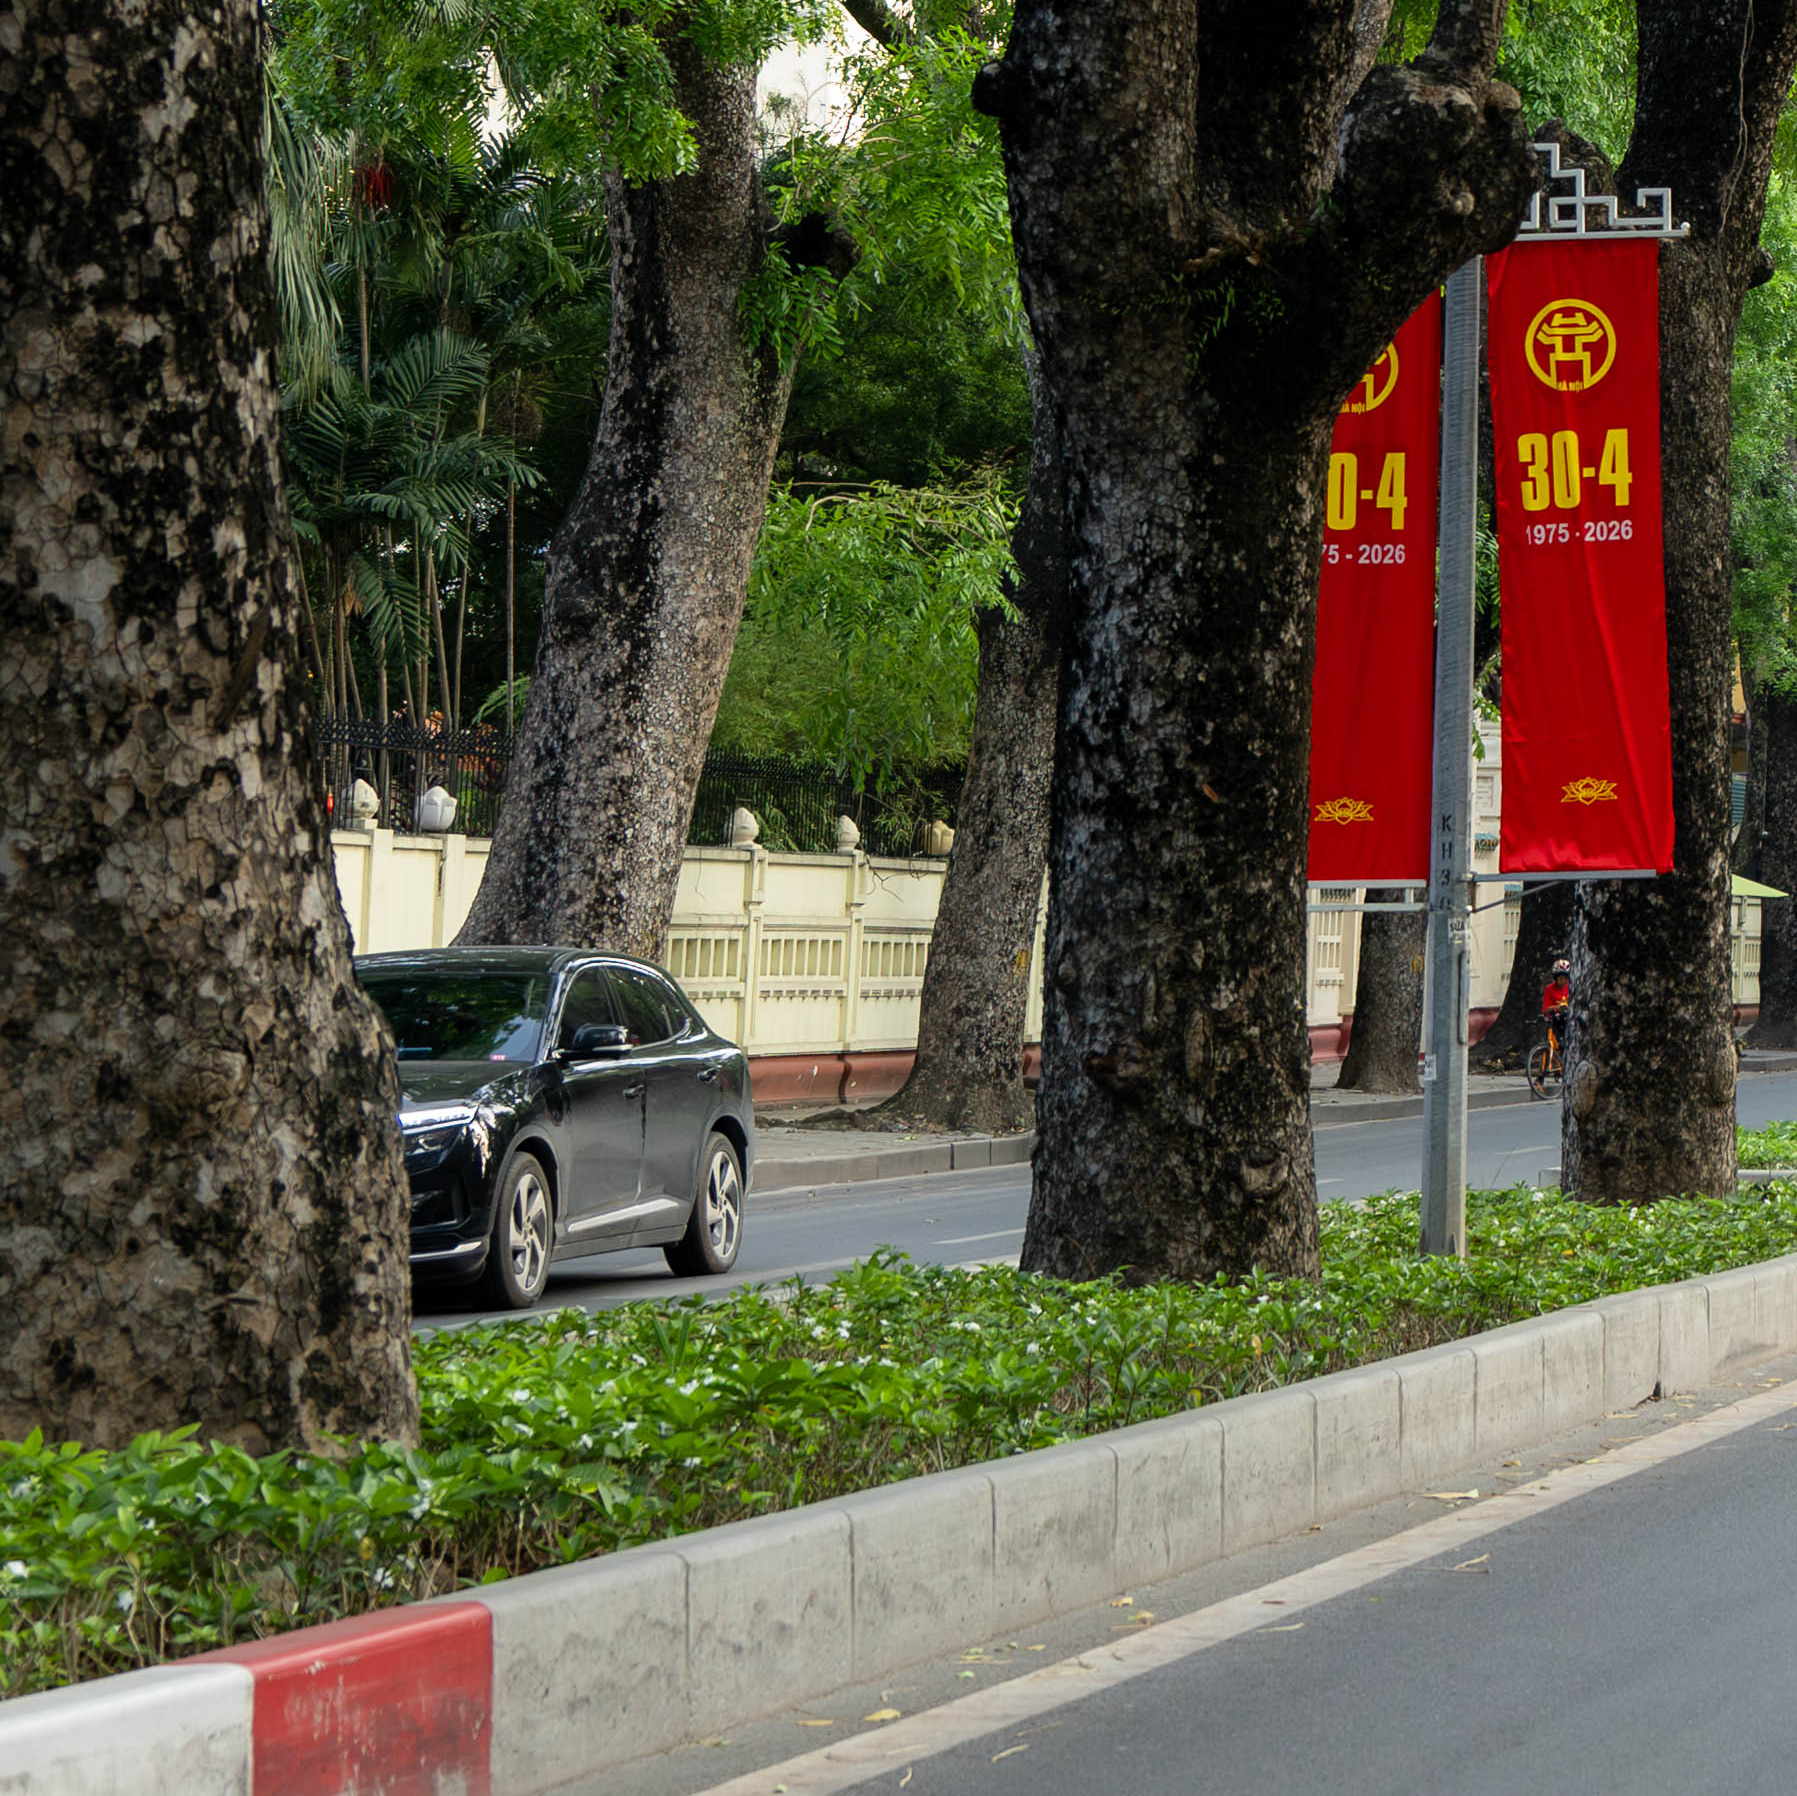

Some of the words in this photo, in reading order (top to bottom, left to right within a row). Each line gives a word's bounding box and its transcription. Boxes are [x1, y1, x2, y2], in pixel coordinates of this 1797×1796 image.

[1326, 452, 1408, 531] 0-4
[1517, 428, 1633, 511] 30-4
[1358, 544, 1406, 564] 2026
[1525, 522, 1570, 545] 1975
[1584, 519, 1633, 542] 2026
